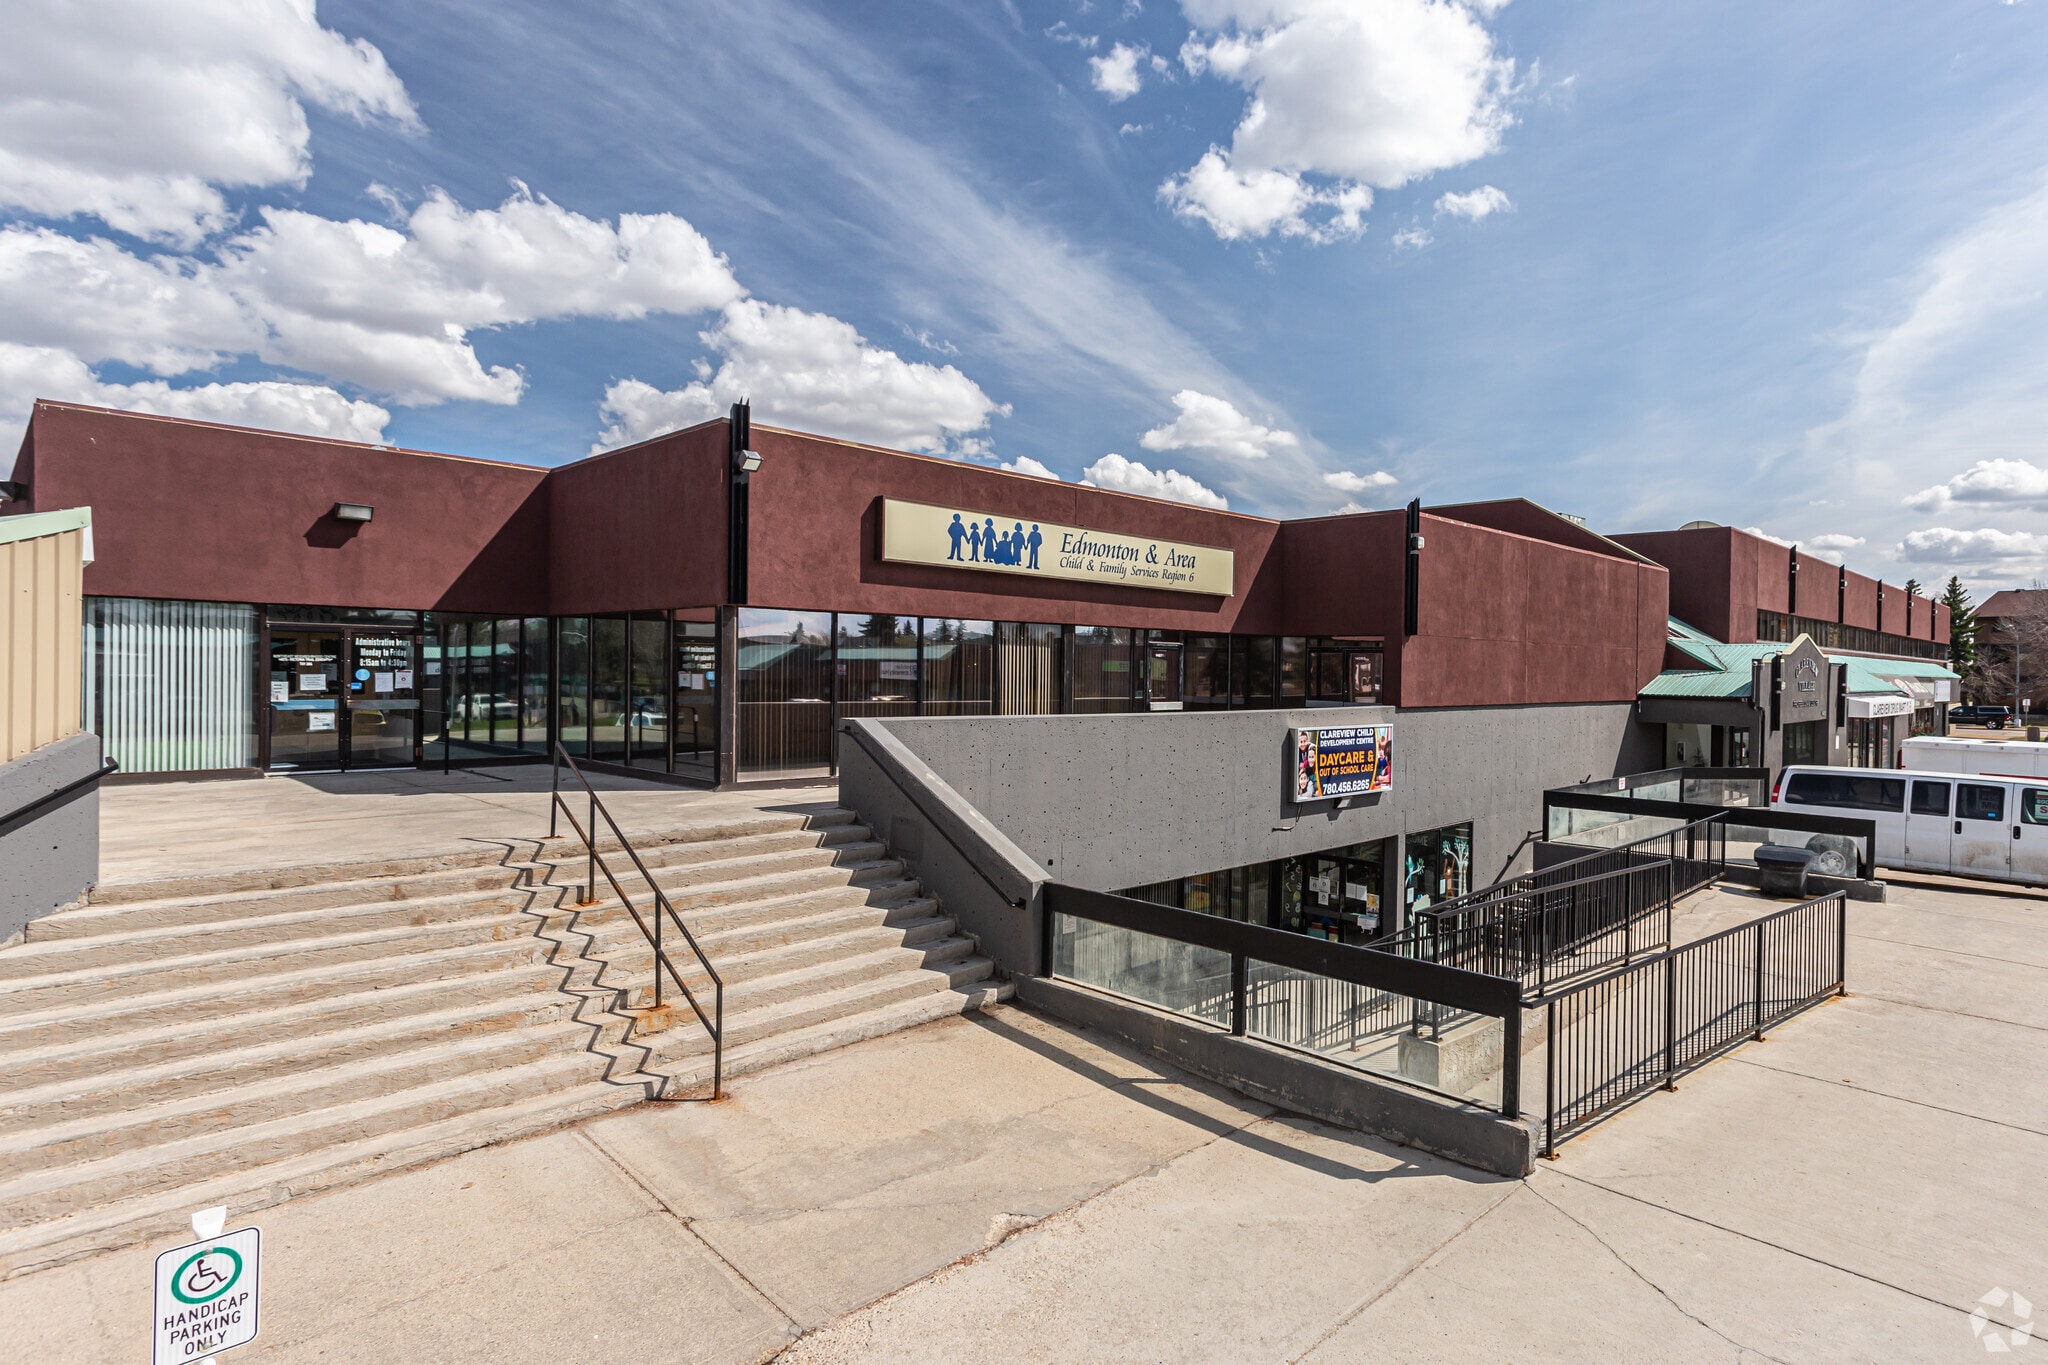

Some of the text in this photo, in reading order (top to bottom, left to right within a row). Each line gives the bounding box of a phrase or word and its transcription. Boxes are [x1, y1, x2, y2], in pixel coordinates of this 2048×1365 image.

[1060, 532, 1196, 569] Edmonton & Area
[1060, 555, 1194, 585] Child & Family Services Region 6
[355, 637, 395, 646] Administrative
[360, 647, 407, 658] Monday to Friday
[1320, 728, 1374, 738] CLAREVIEW CHILD
[1320, 739, 1355, 747] DEVELOPMENT
[1320, 750, 1374, 766] DAYCARE &
[1319, 764, 1374, 776] OUT OF SCHOOL CARE
[164, 1292, 249, 1331] HANDICAP
[170, 1310, 241, 1345] PARKING
[185, 1329, 227, 1356] ONLY
